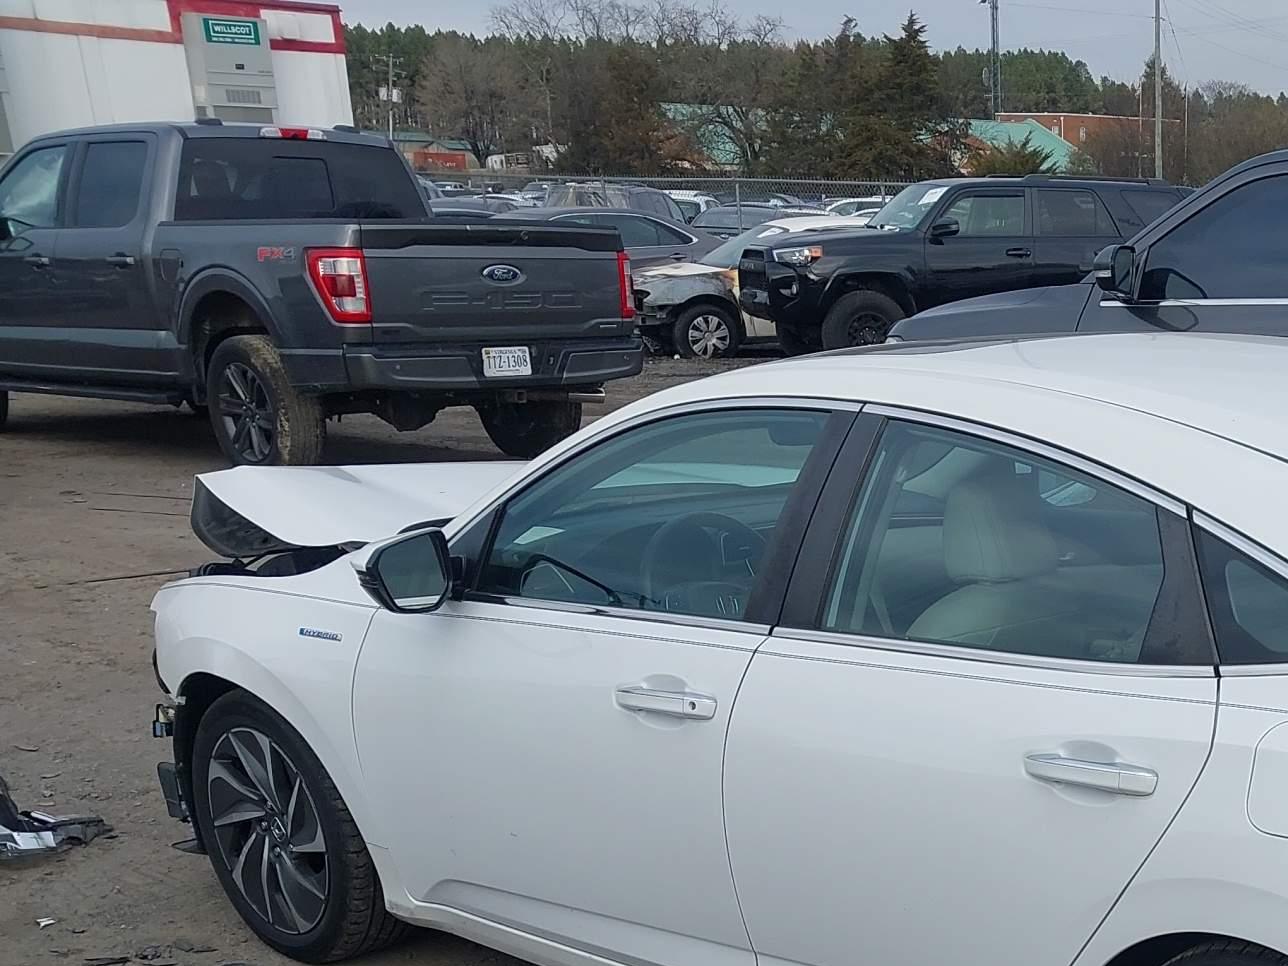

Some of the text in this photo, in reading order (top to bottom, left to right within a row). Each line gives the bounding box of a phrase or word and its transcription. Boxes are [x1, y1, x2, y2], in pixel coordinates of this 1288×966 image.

[213, 24, 251, 35] WILLSCOT
[257, 246, 296, 262] FX4
[492, 267, 515, 280] Ford
